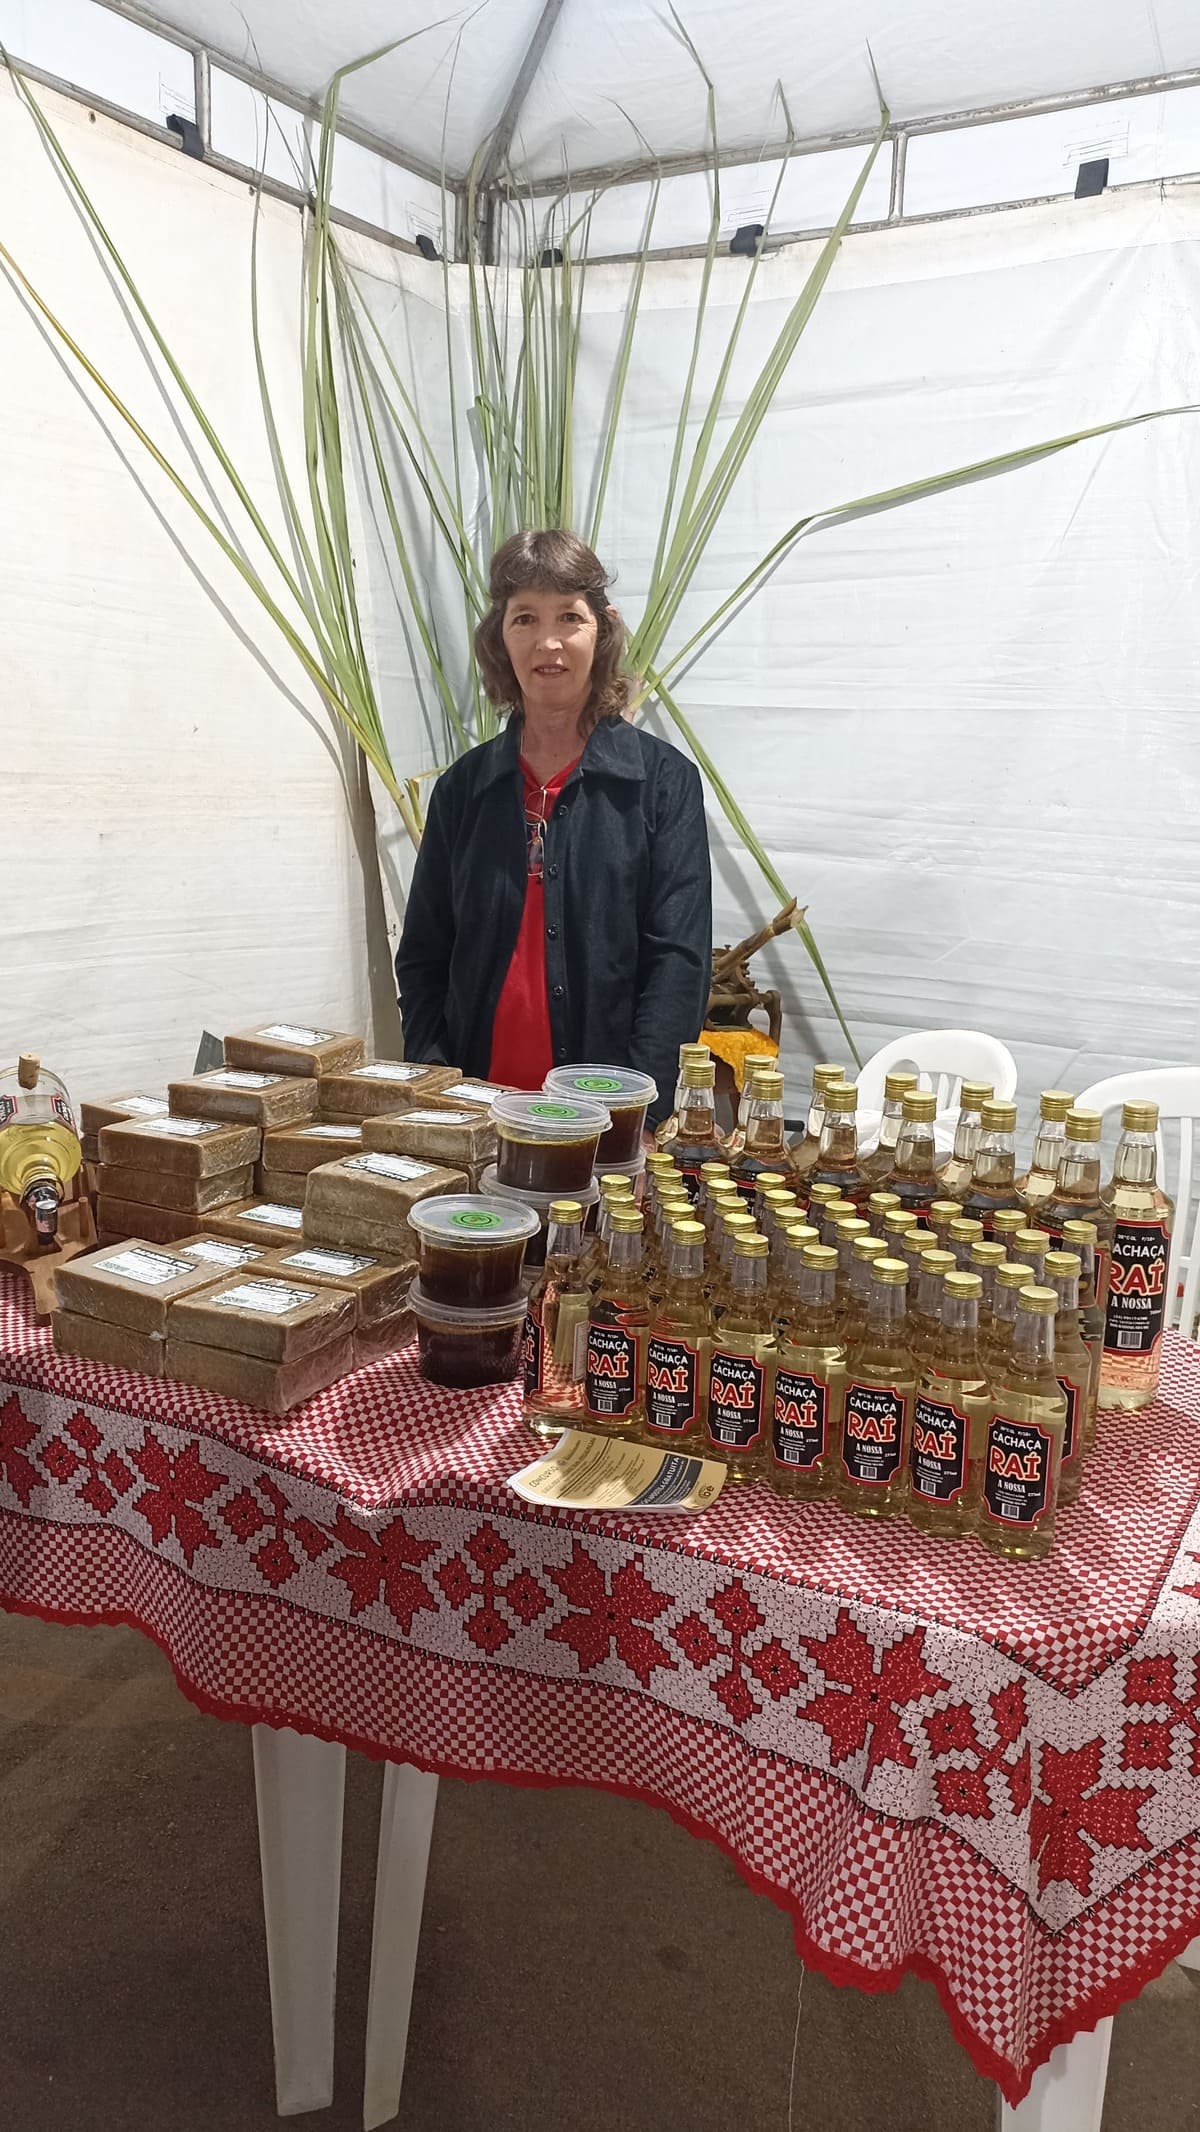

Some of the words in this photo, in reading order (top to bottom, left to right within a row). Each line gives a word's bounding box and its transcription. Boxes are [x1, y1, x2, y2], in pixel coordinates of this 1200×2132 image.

[1112, 1242, 1165, 1259] ACHAÇA
[1109, 1257, 1165, 1295] RAÍ
[1111, 1295, 1119, 1308] A
[1121, 1297, 1152, 1309] NOSSA
[588, 1336, 629, 1352] CACHAÇA
[587, 1349, 629, 1378] RAÍ
[648, 1348, 689, 1365] CACHAÇA
[647, 1361, 688, 1393] RAÍ
[712, 1363, 756, 1381] CACHAÇA
[711, 1376, 755, 1408] RAÍ
[776, 1381, 817, 1400] CACHAÇA
[775, 1394, 817, 1428] RAÍ
[849, 1396, 897, 1414] CACHAÇA
[847, 1410, 896, 1443] RAÍ
[915, 1408, 957, 1430] CACHAÇA
[861, 1444, 883, 1455] NOSSA
[913, 1422, 957, 1460] RAÍ
[992, 1430, 1042, 1452] CACHAÇA
[989, 1445, 1042, 1481] RAÍ
[997, 1479, 1003, 1489] A
[1003, 1481, 1026, 1493] NOSSA
